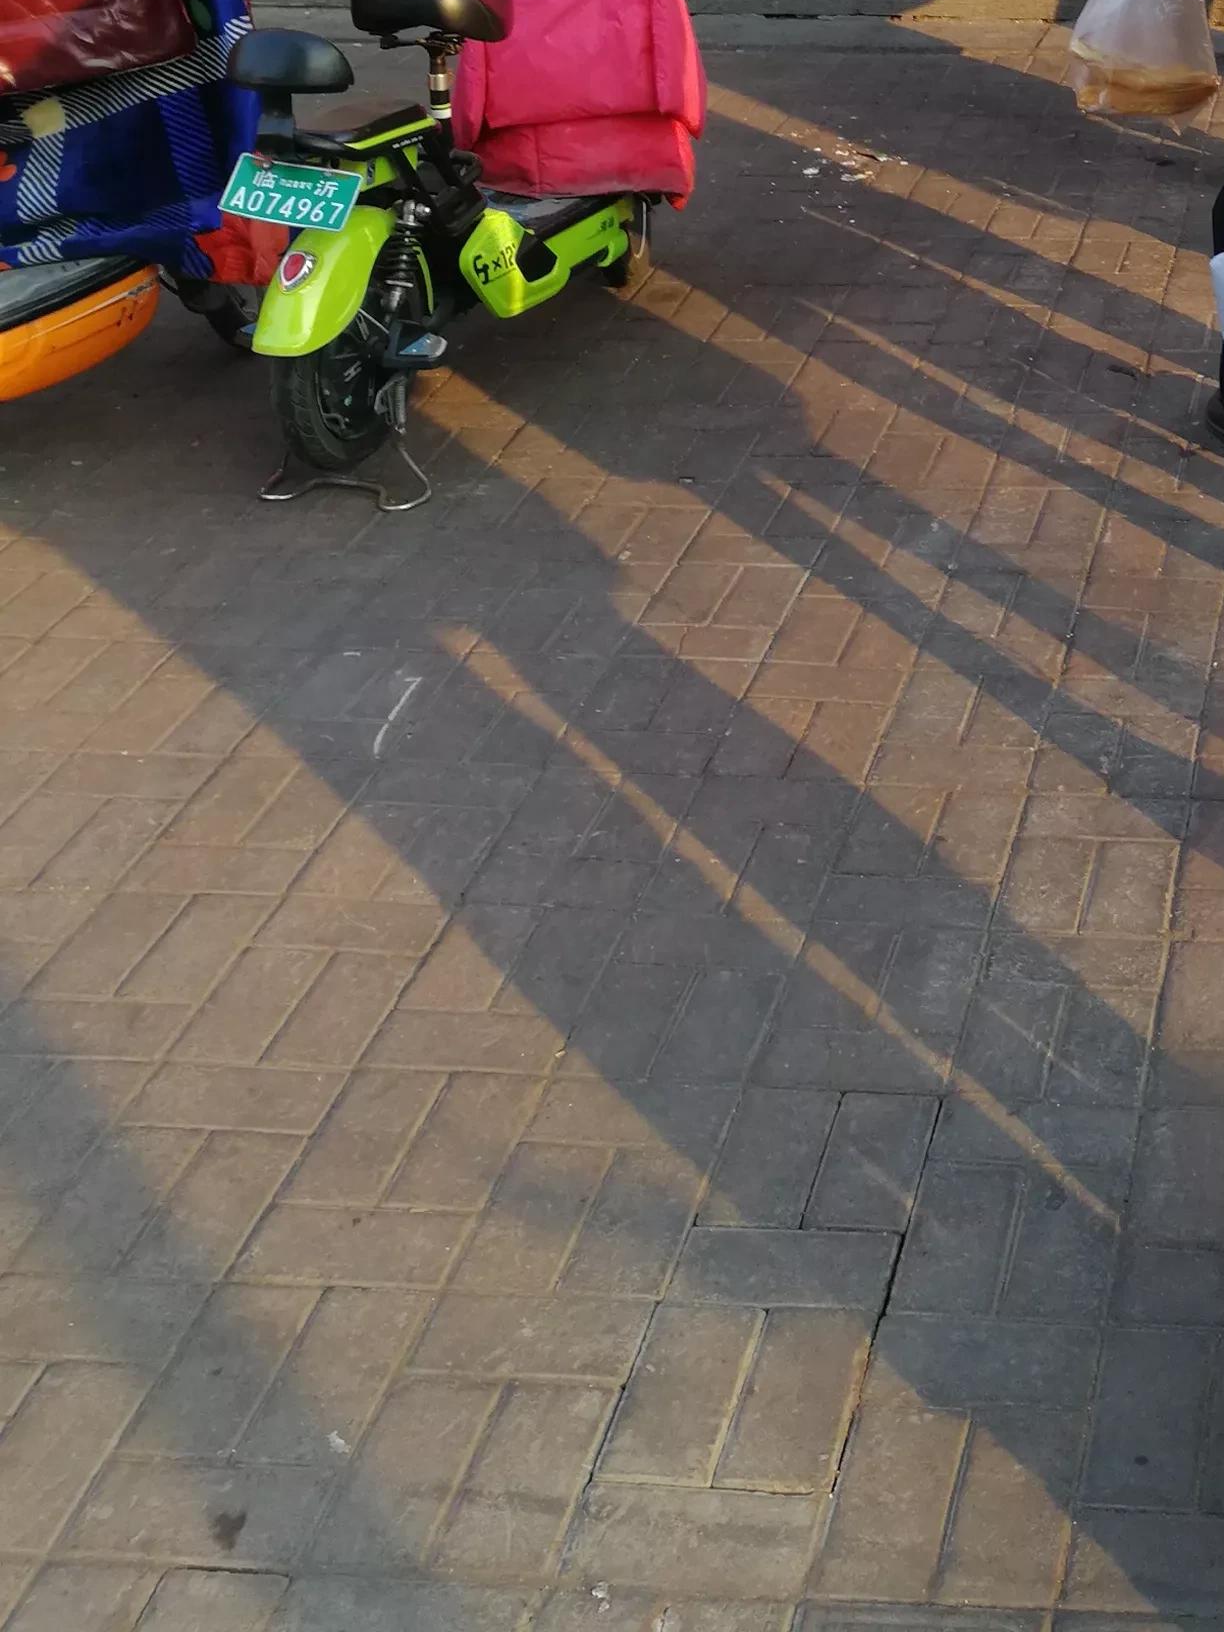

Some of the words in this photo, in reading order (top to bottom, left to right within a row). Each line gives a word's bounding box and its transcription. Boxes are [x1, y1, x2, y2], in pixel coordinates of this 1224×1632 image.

[252, 170, 278, 190] 临
[313, 180, 339, 199] 沂
[229, 186, 345, 226] A074967
